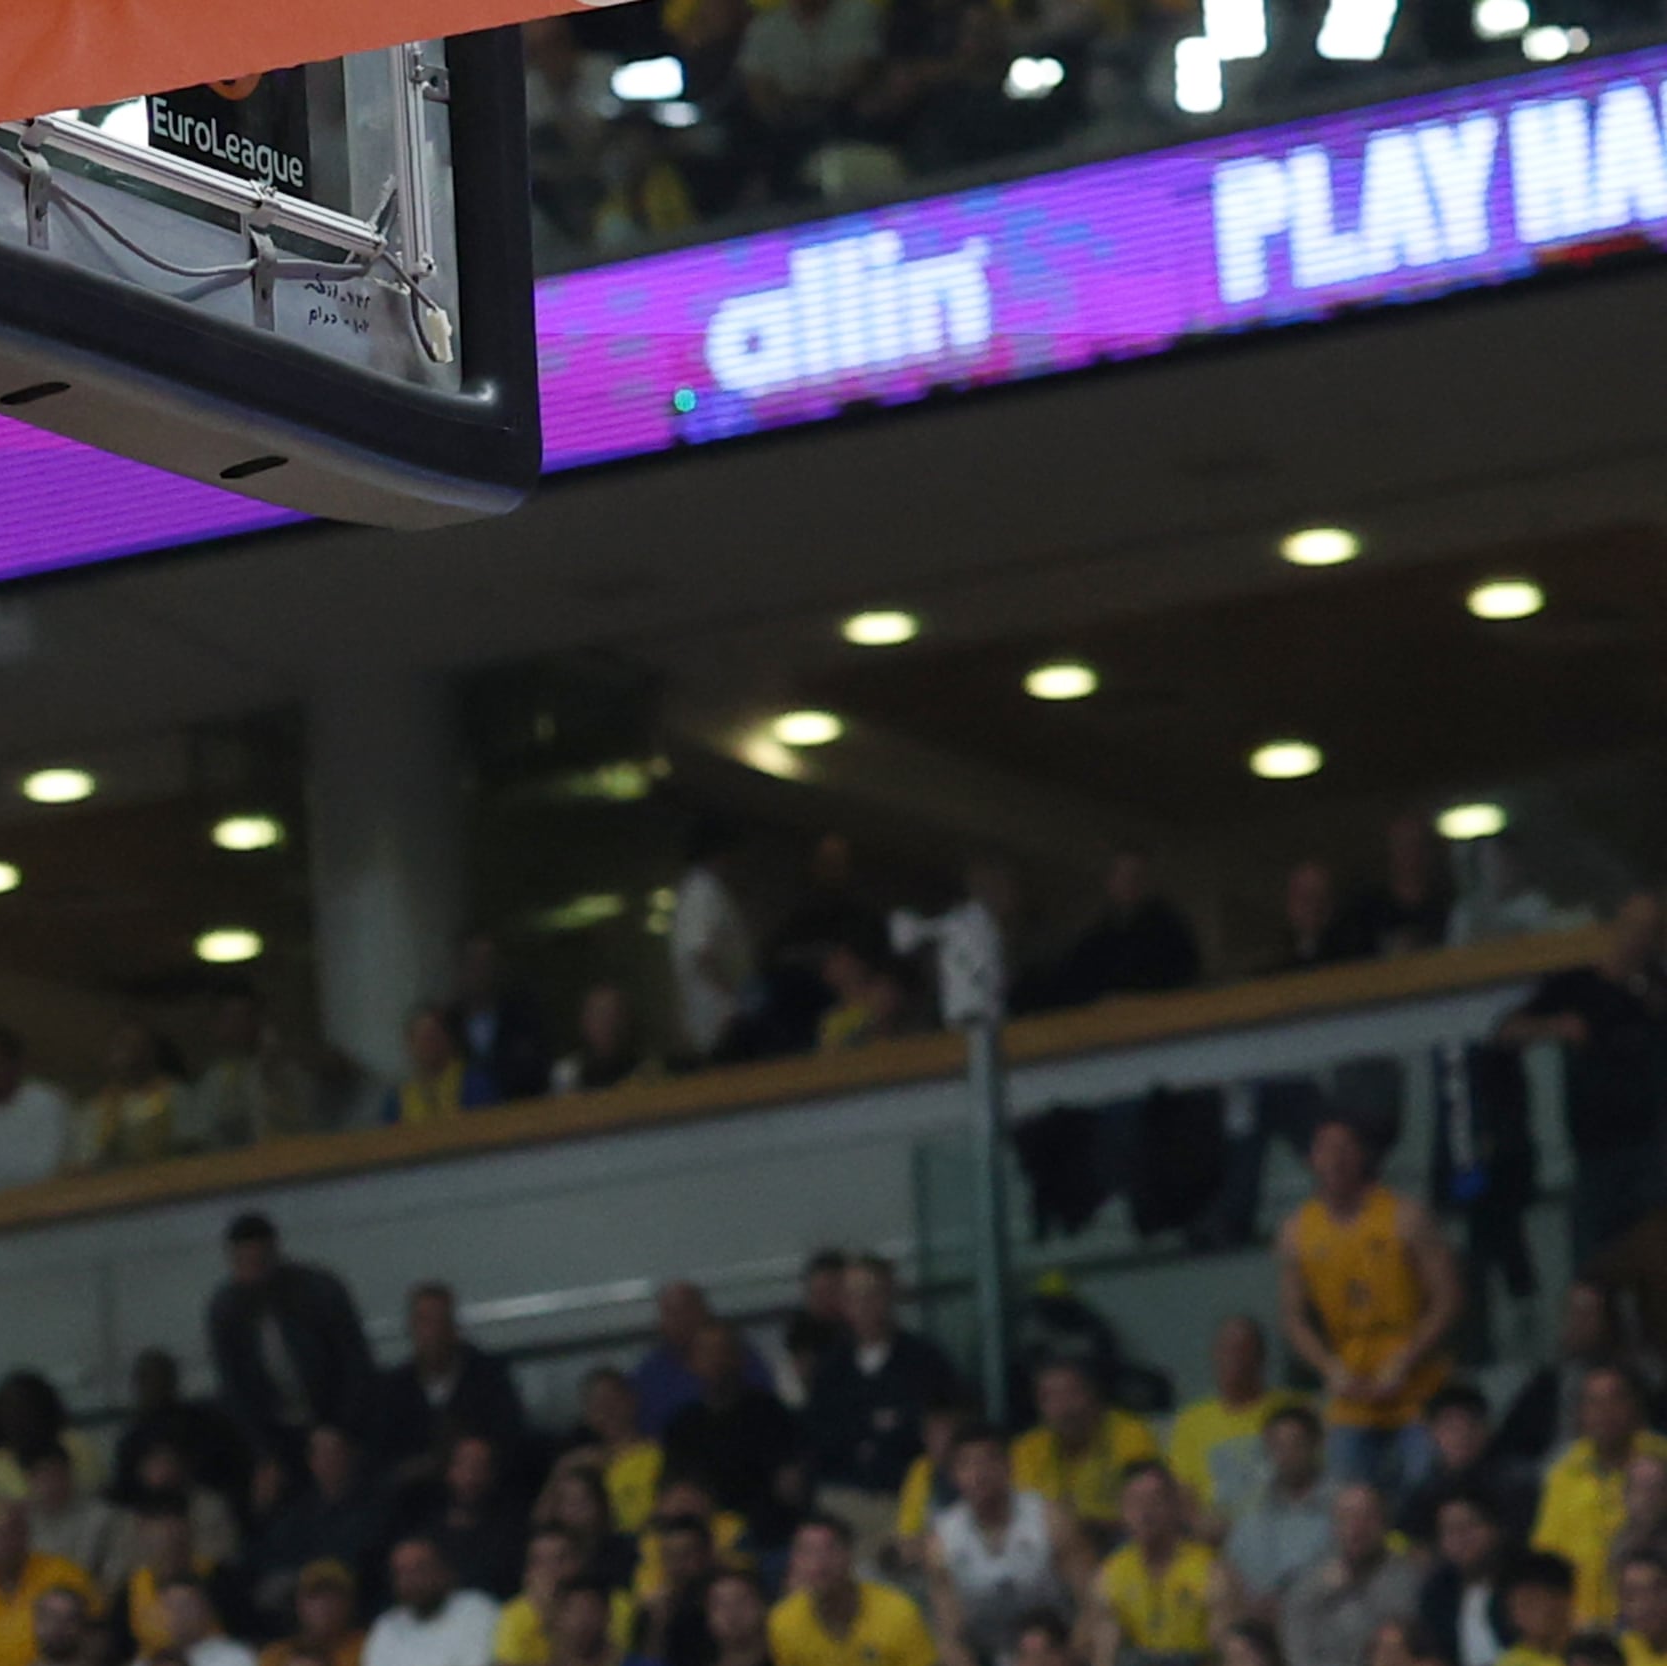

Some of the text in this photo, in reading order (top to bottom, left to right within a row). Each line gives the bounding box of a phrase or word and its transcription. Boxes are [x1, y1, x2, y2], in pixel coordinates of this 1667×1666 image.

[151, 97, 304, 186] EuroLeague
[1213, 66, 1667, 305] PLAY HA
